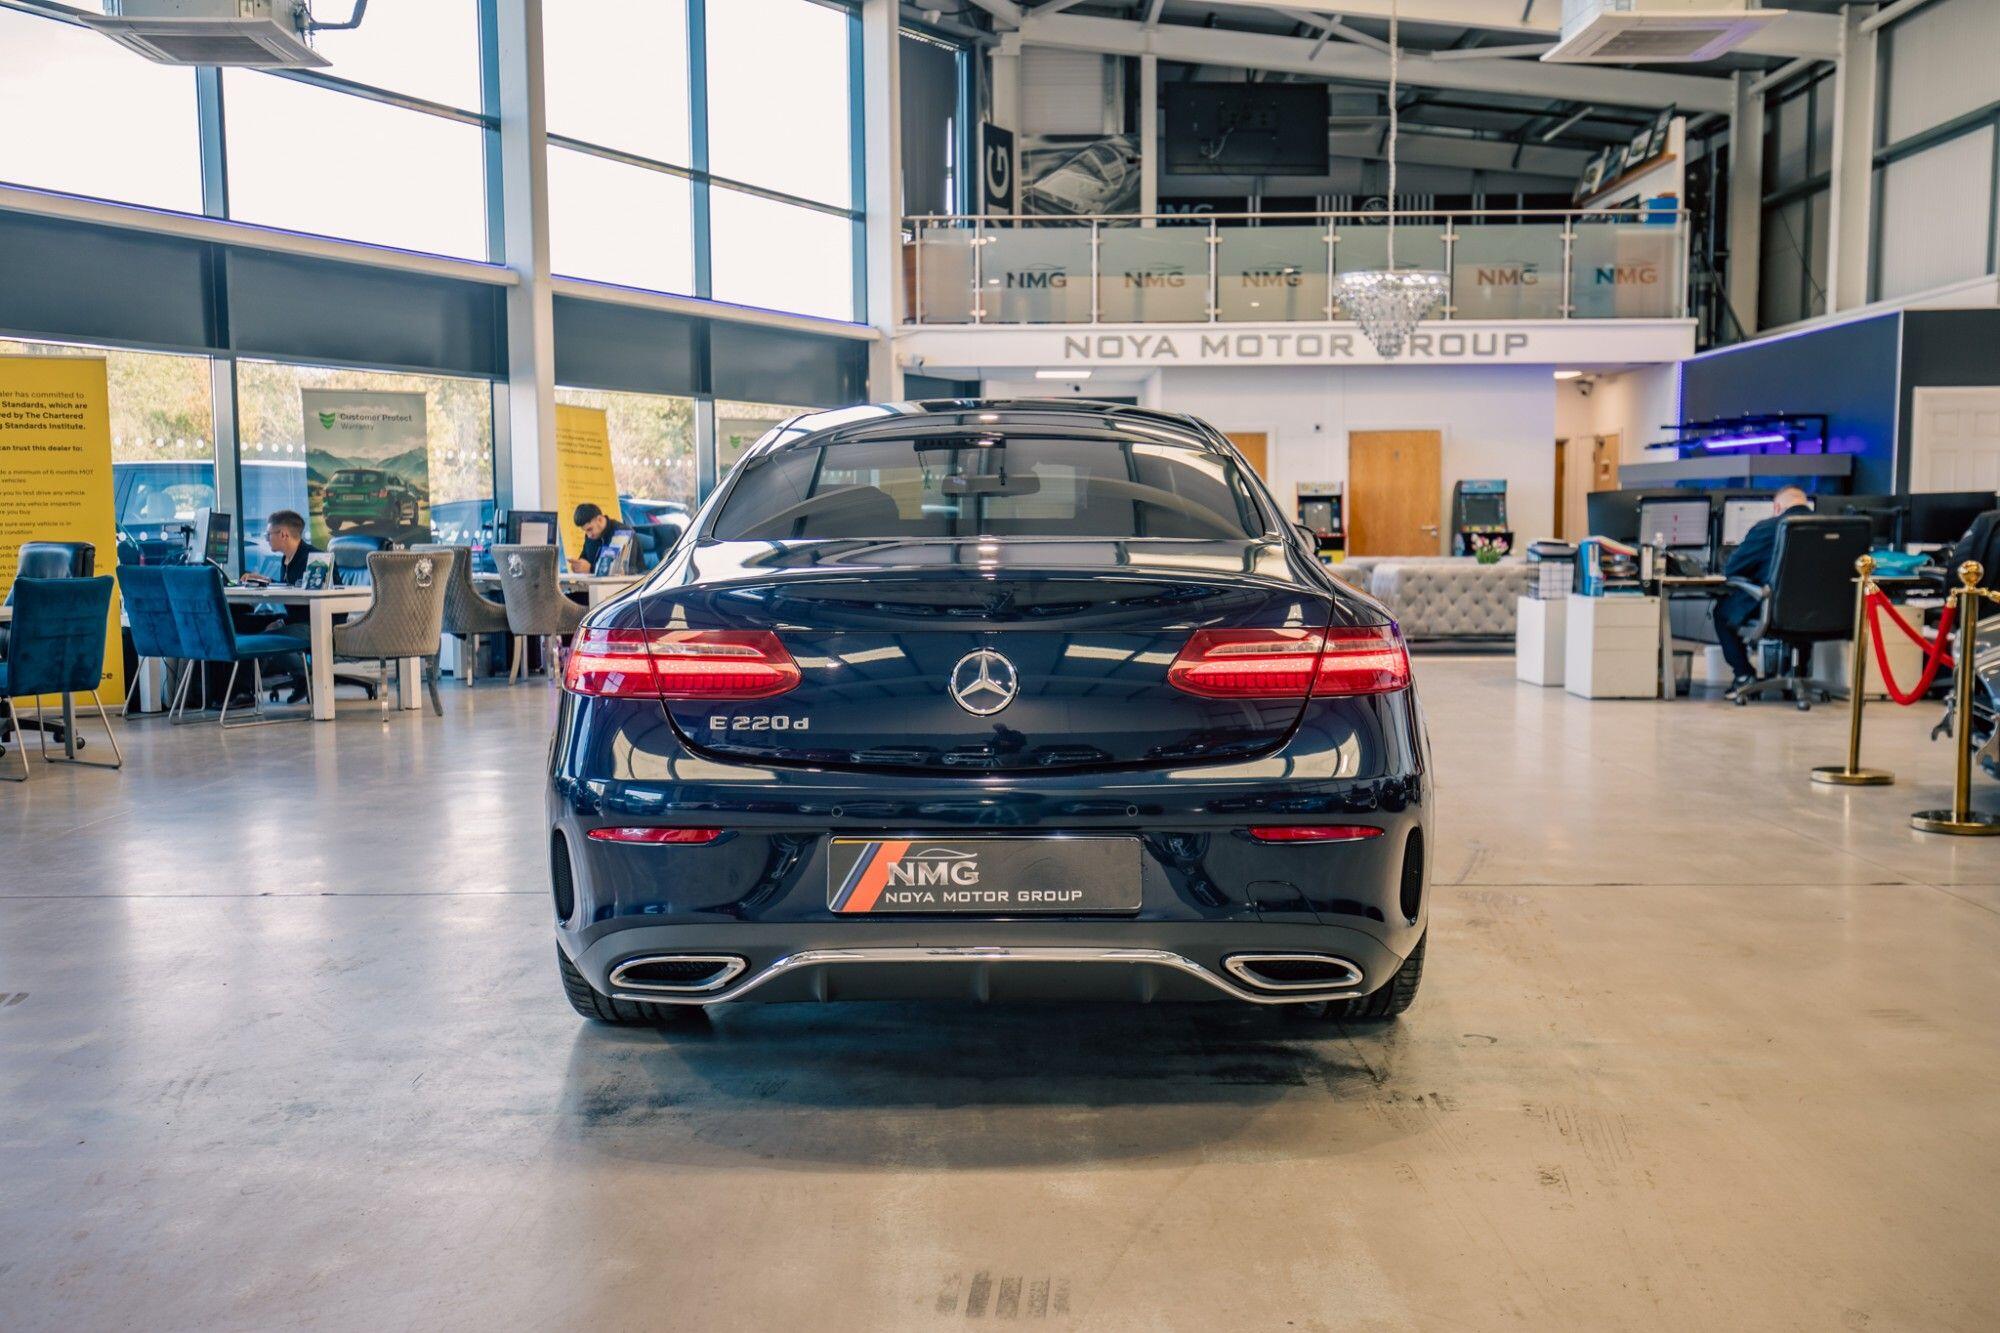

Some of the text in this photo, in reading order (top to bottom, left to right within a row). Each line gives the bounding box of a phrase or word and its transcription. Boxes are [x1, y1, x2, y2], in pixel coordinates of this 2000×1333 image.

[1006, 271, 1068, 289] NMG
[1124, 271, 1185, 288] NMG
[1242, 271, 1303, 287] NMG
[1477, 267, 1539, 286] NMG
[1596, 267, 1658, 285] NMG
[1064, 335, 1179, 358] NOYA
[1201, 334, 1354, 357] MOTOR
[15, 390, 29, 398] has
[31, 391, 75, 399] committed
[2, 400, 47, 409] Standards,
[14, 412, 23, 420] by
[42, 412, 84, 420] Chartered
[340, 413, 412, 422] Customer Protect
[5, 422, 47, 430] Standards
[886, 860, 979, 886] NMG
[885, 890, 1083, 903] NOYA MOTOR GROUP
